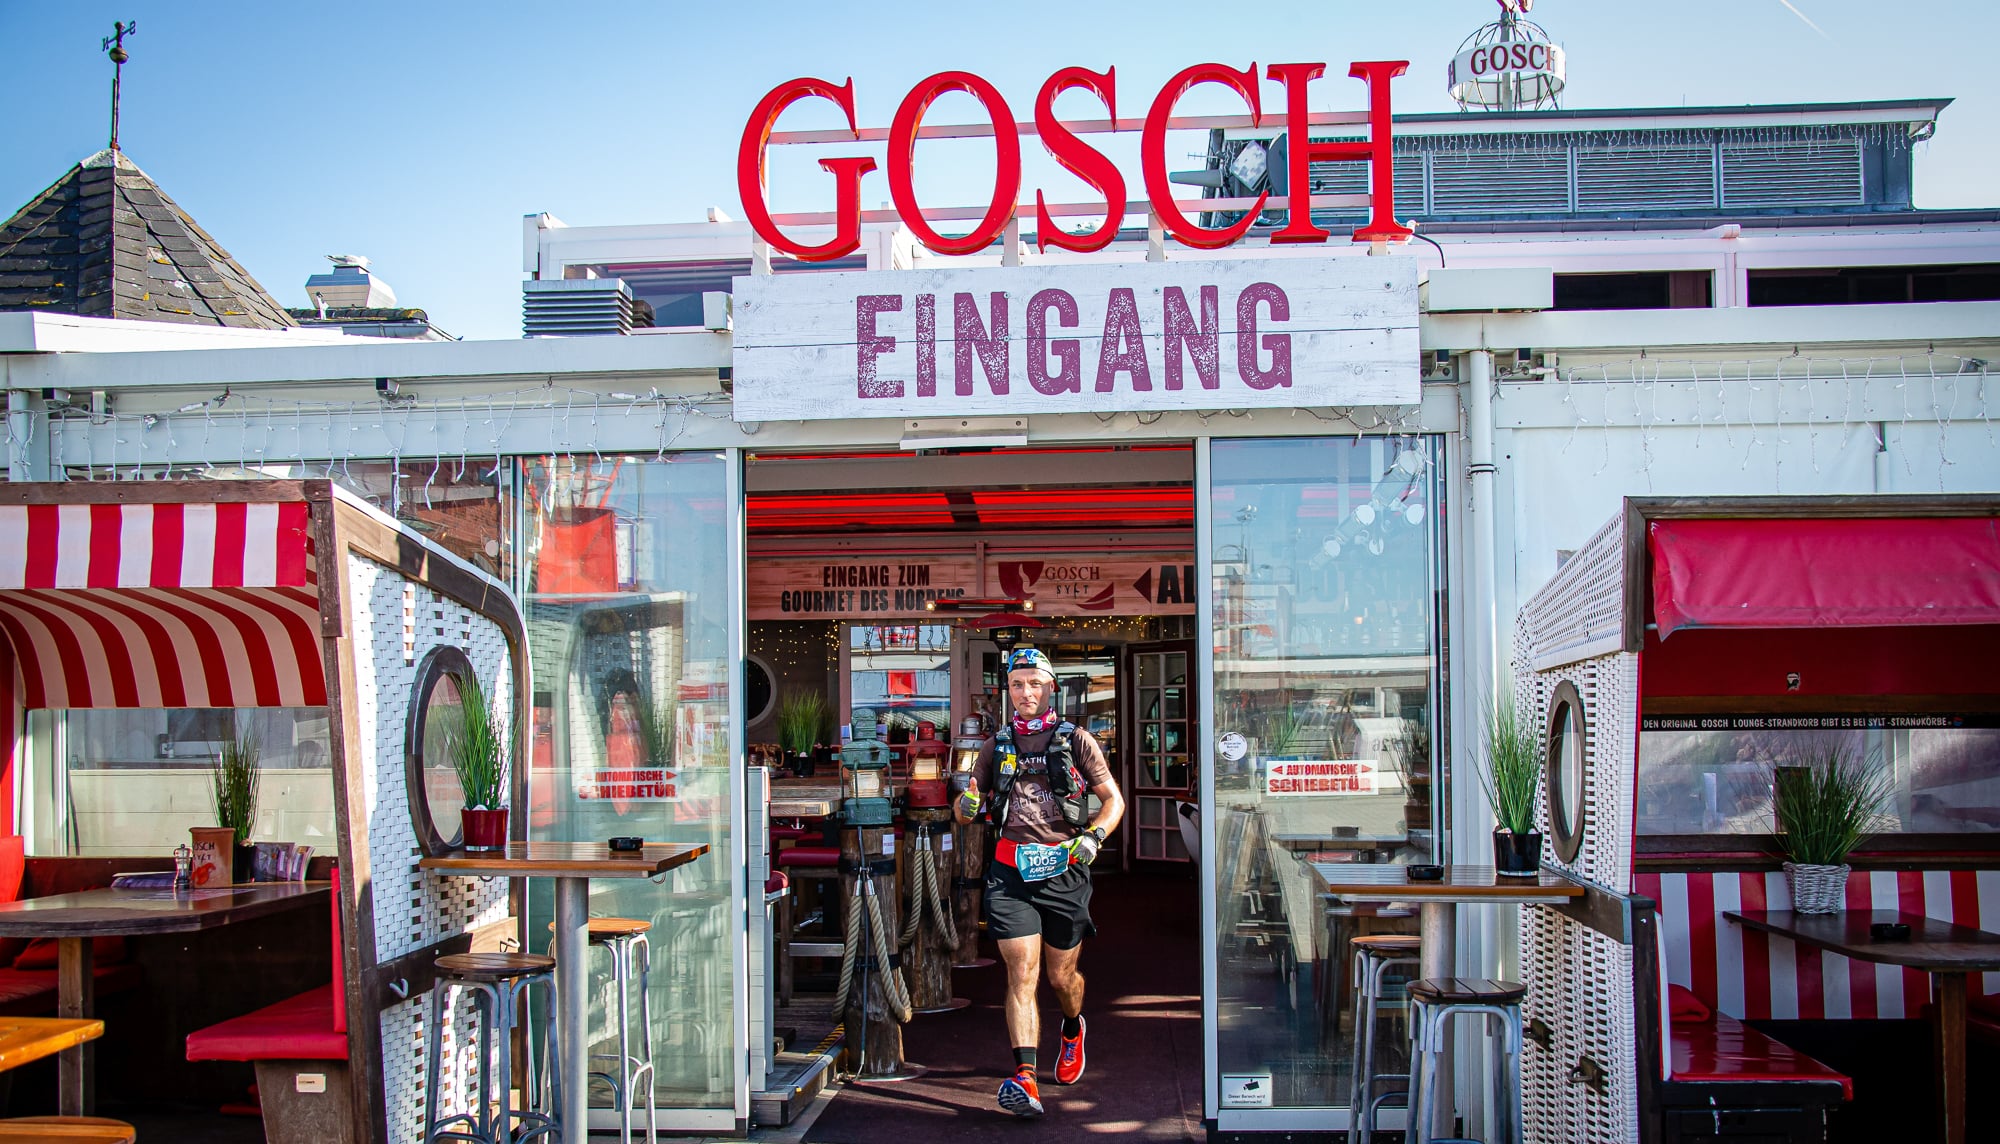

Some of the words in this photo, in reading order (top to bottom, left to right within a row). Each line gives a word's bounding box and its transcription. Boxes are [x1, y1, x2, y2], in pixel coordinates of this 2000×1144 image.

[1471, 44, 1556, 75] GOSCH
[737, 60, 1416, 263] GOSCH
[856, 281, 1293, 399] EINGANG
[823, 565, 890, 587] EINGANG
[898, 565, 930, 586] ZUM
[1045, 566, 1100, 580] GOSCH
[781, 590, 855, 612] GOURMET
[860, 589, 889, 611] DES
[1643, 719, 1659, 729] DEN
[1661, 719, 1698, 728] ORIGINAL
[1701, 719, 1729, 728] GOSCH
[1733, 718, 1819, 728] LOUNGE-STRANDKORB
[1821, 717, 1839, 727] GIBT
[1841, 717, 1851, 727] ES
[1853, 717, 1866, 727] BEI
[1868, 717, 1885, 727] SYLT
[595, 771, 663, 782] AUTOMATISCHE
[1286, 763, 1358, 776] AUTOMATISCHE
[578, 782, 676, 799] SCHIEBETÜR
[1269, 776, 1372, 793] SCHIEBETÜR
[1028, 855, 1057, 866] 1005
